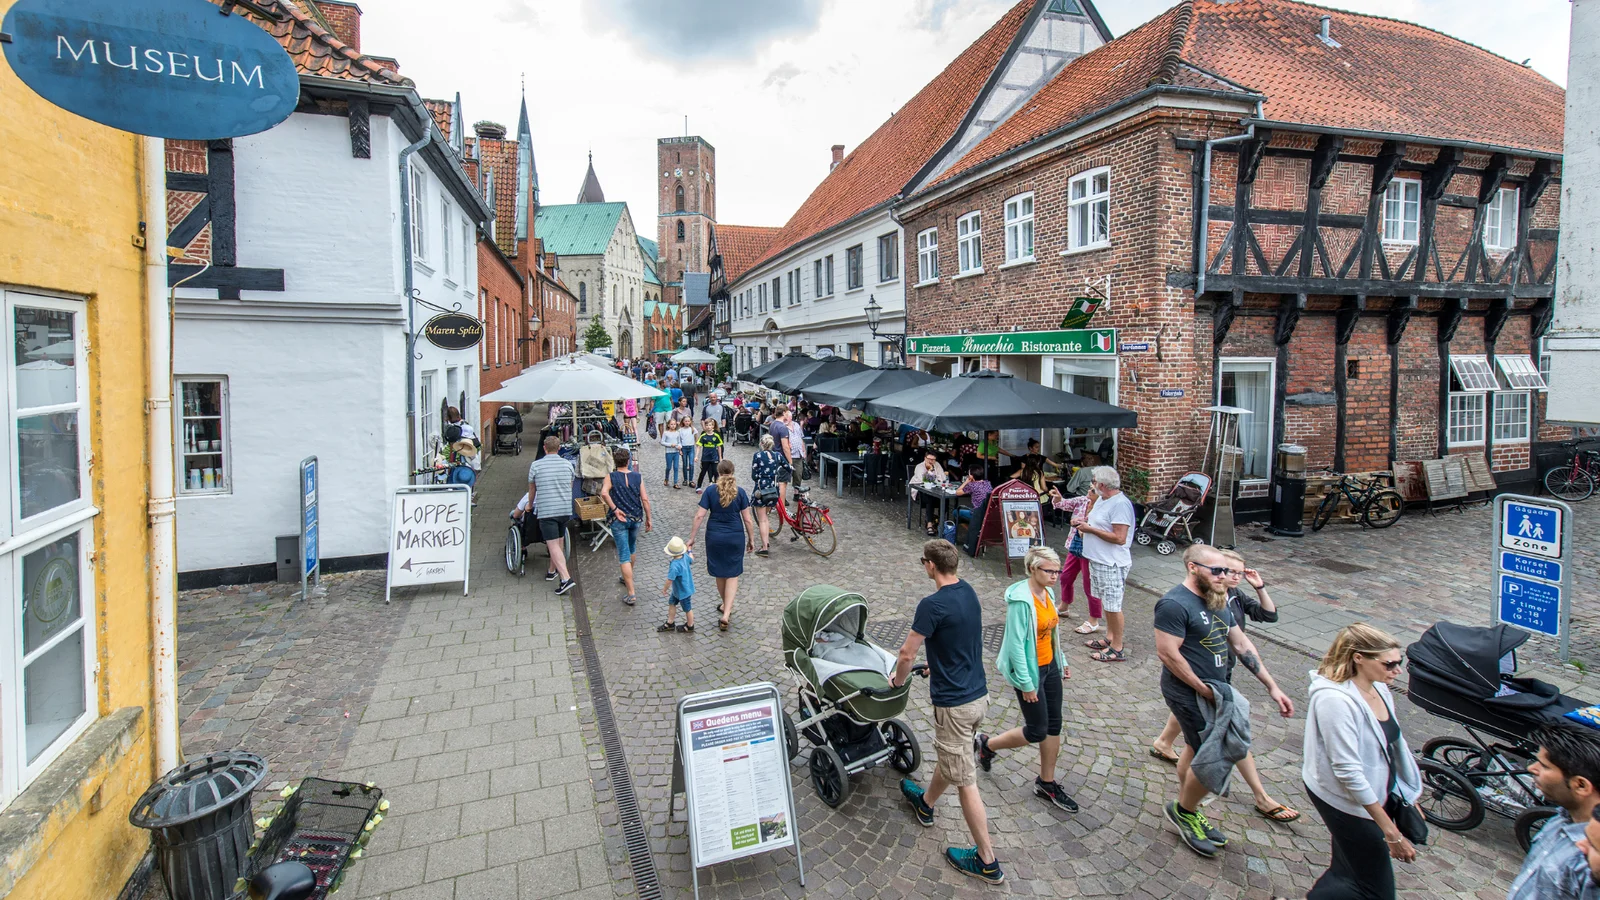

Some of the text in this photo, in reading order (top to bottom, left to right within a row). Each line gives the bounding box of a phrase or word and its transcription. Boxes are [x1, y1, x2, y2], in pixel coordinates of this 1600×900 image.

[56, 35, 264, 89] MUSEUM
[426, 325, 481, 338] Maren Splid
[922, 336, 1082, 352] Pizzeria Pinocchio Ristorante
[402, 498, 464, 524] LOPPE-
[1515, 505, 1548, 516] Gågade
[397, 526, 464, 550] MARKED
[1514, 538, 1548, 551] Zone
[1515, 557, 1548, 568] Kørsel
[1516, 564, 1547, 576] tilladt
[1509, 584, 1519, 593] P
[1520, 602, 1547, 612] timer
[706, 710, 762, 727] Quedens menu
